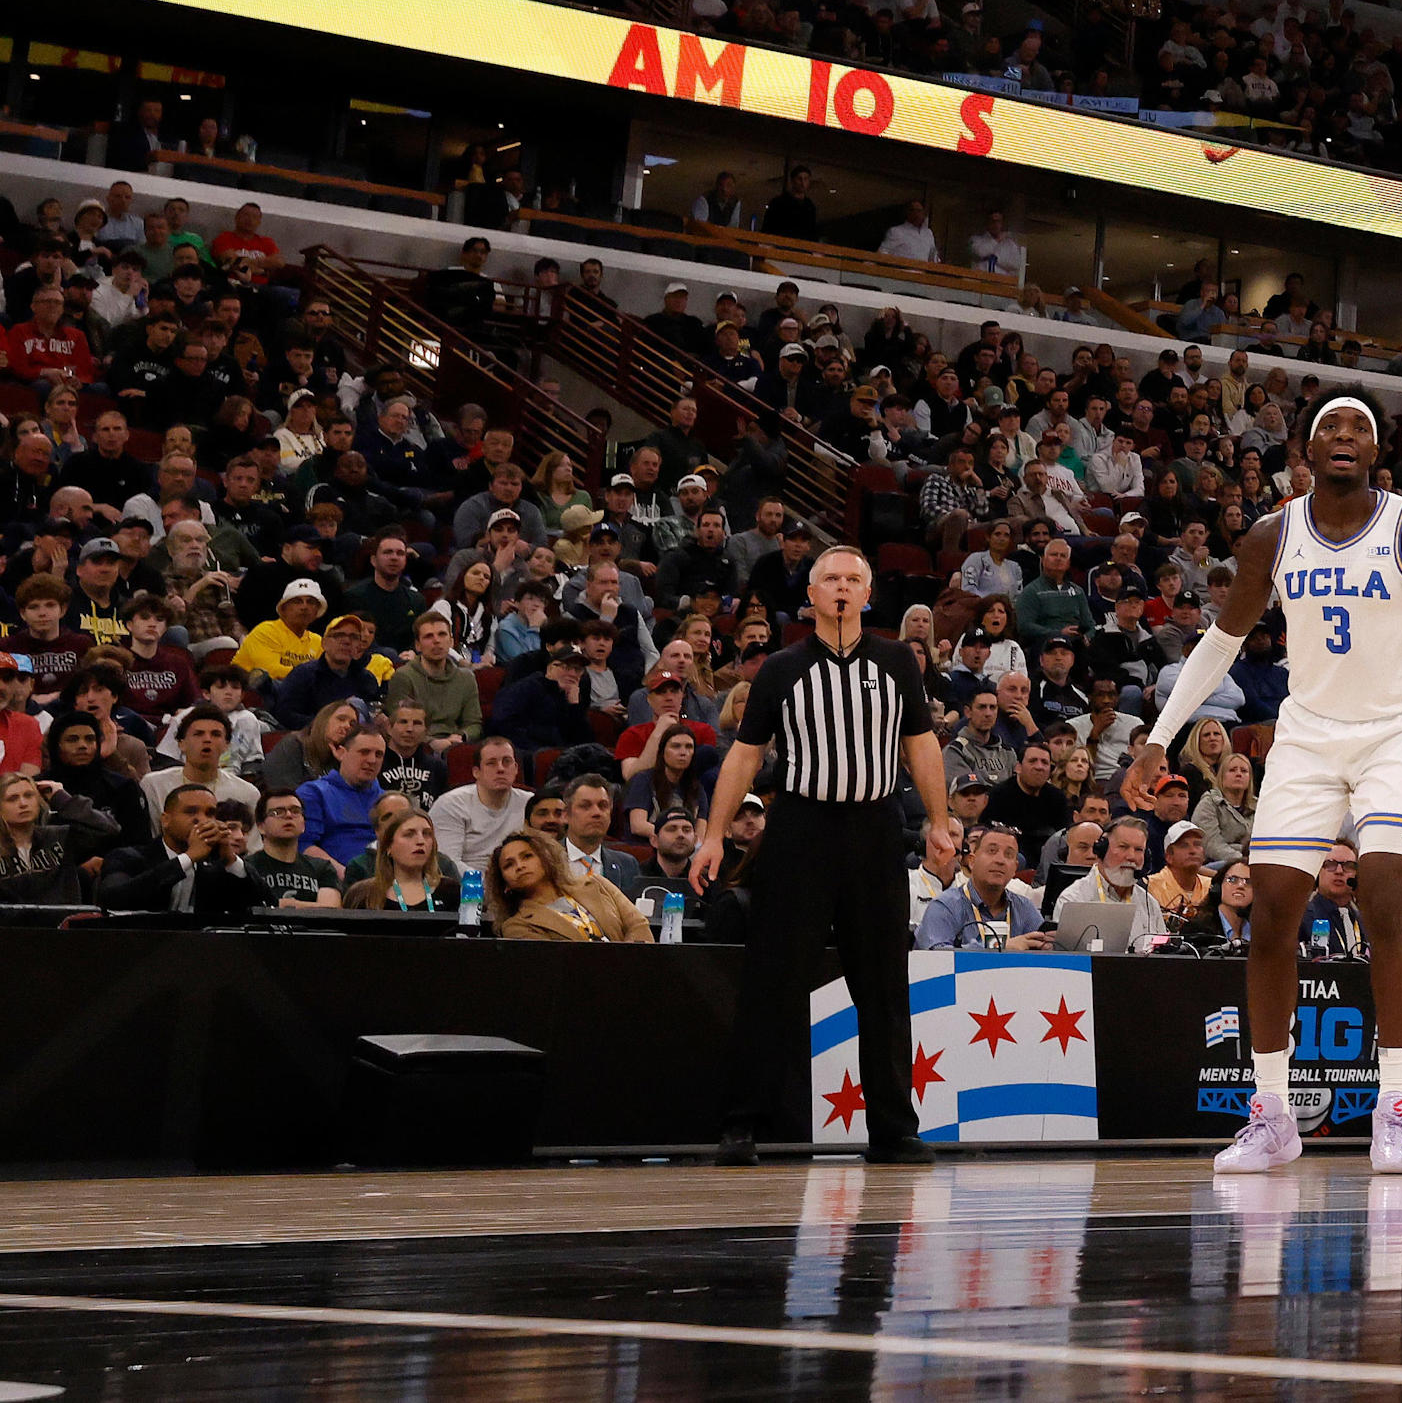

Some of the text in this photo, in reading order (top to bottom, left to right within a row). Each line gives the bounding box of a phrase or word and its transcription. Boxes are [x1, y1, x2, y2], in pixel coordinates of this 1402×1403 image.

[608, 24, 996, 157] AM IO S
[1285, 568, 1391, 600] UCLA
[1323, 606, 1352, 655] 3
[862, 680, 877, 690] TW
[383, 767, 431, 784] PURDUE
[280, 873, 318, 892] GREEN
[1299, 980, 1341, 999] TIAA
[1288, 1006, 1364, 1061] 1G
[1199, 1068, 1239, 1082] MEN'S
[1242, 1068, 1321, 1083] BATBALL
[1289, 1092, 1321, 1106] 2026
